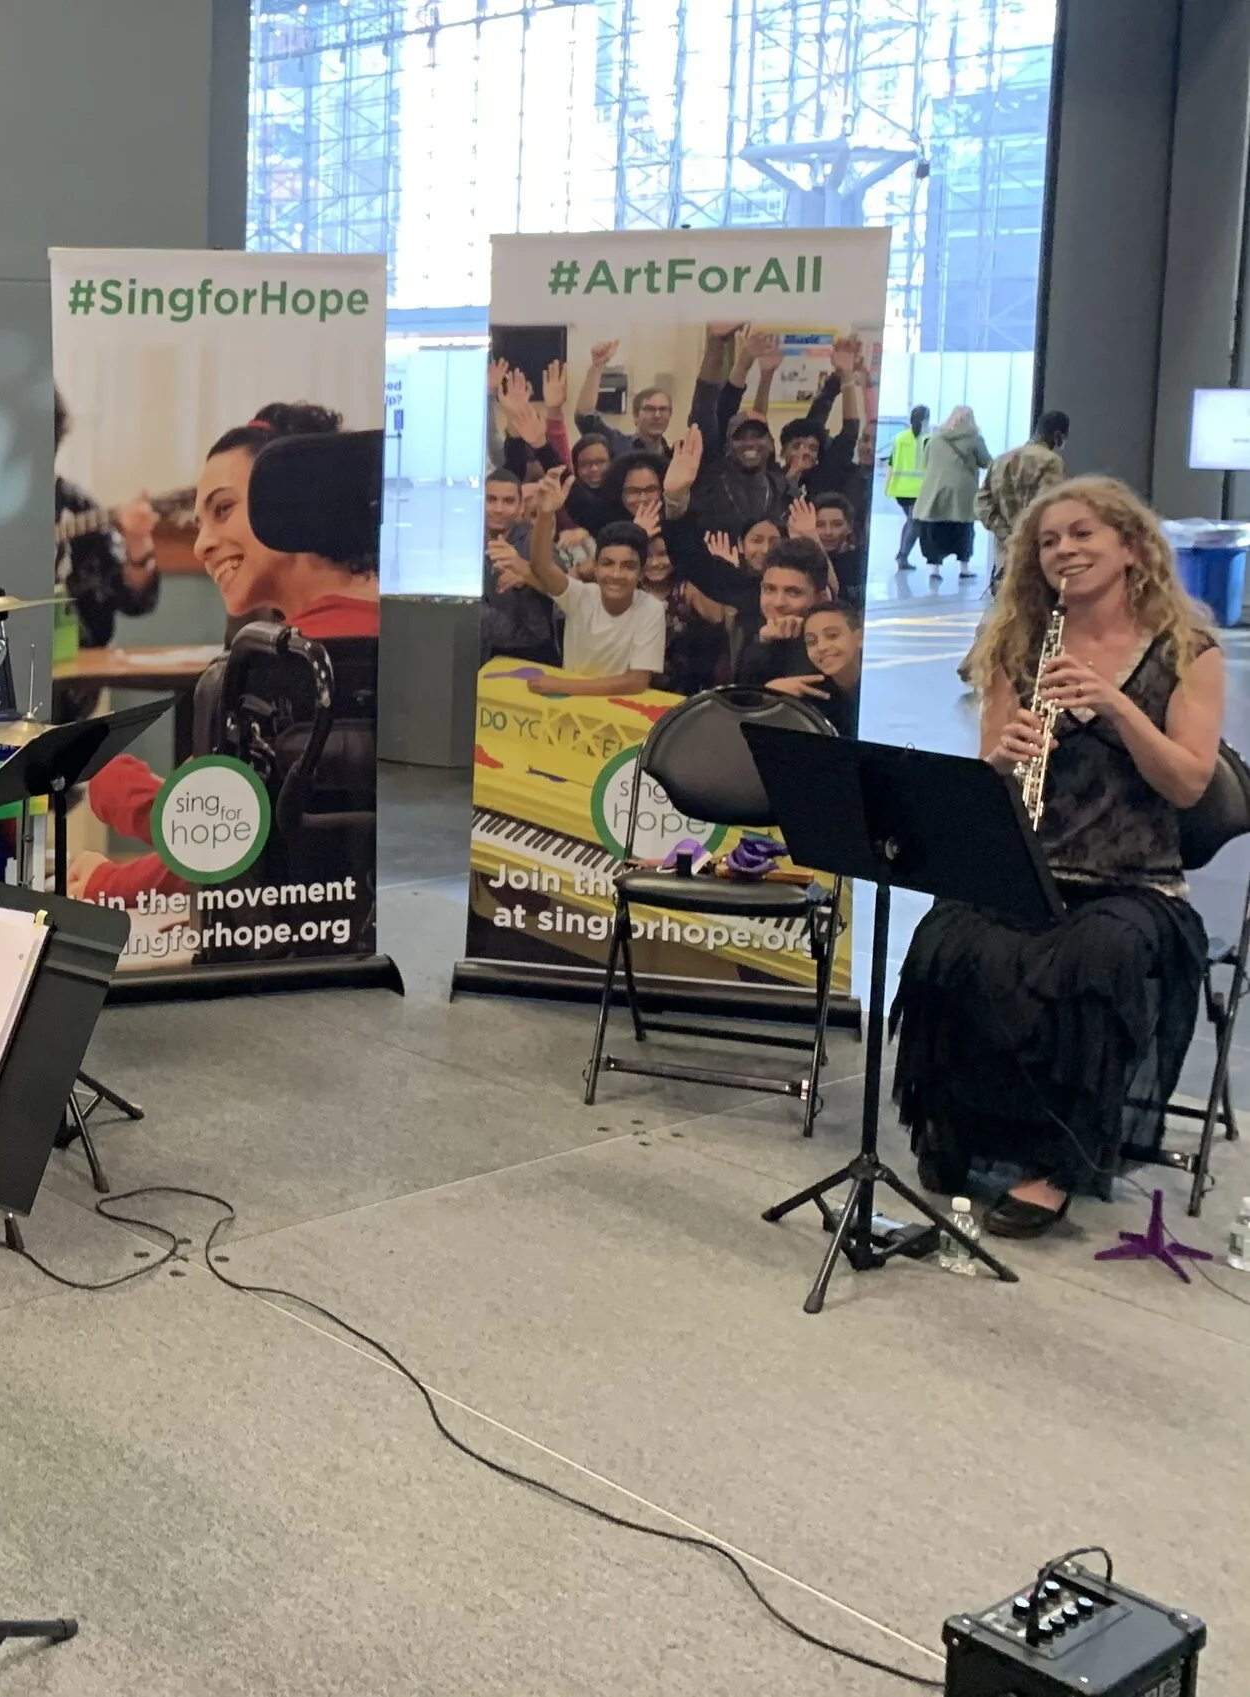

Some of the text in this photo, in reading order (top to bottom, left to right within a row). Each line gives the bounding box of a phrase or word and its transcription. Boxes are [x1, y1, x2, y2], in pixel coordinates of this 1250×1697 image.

[548, 255, 823, 296] #ArtForAll
[68, 278, 370, 323] #SingforHope
[385, 380, 402, 391] ed
[480, 706, 508, 731] DO
[175, 793, 243, 821] sing for
[619, 780, 670, 805] sng
[171, 820, 252, 849] hope
[613, 802, 708, 839] hope
[488, 863, 562, 893] Join
[136, 887, 187, 915] the
[196, 875, 357, 911] movement
[492, 903, 527, 929] at
